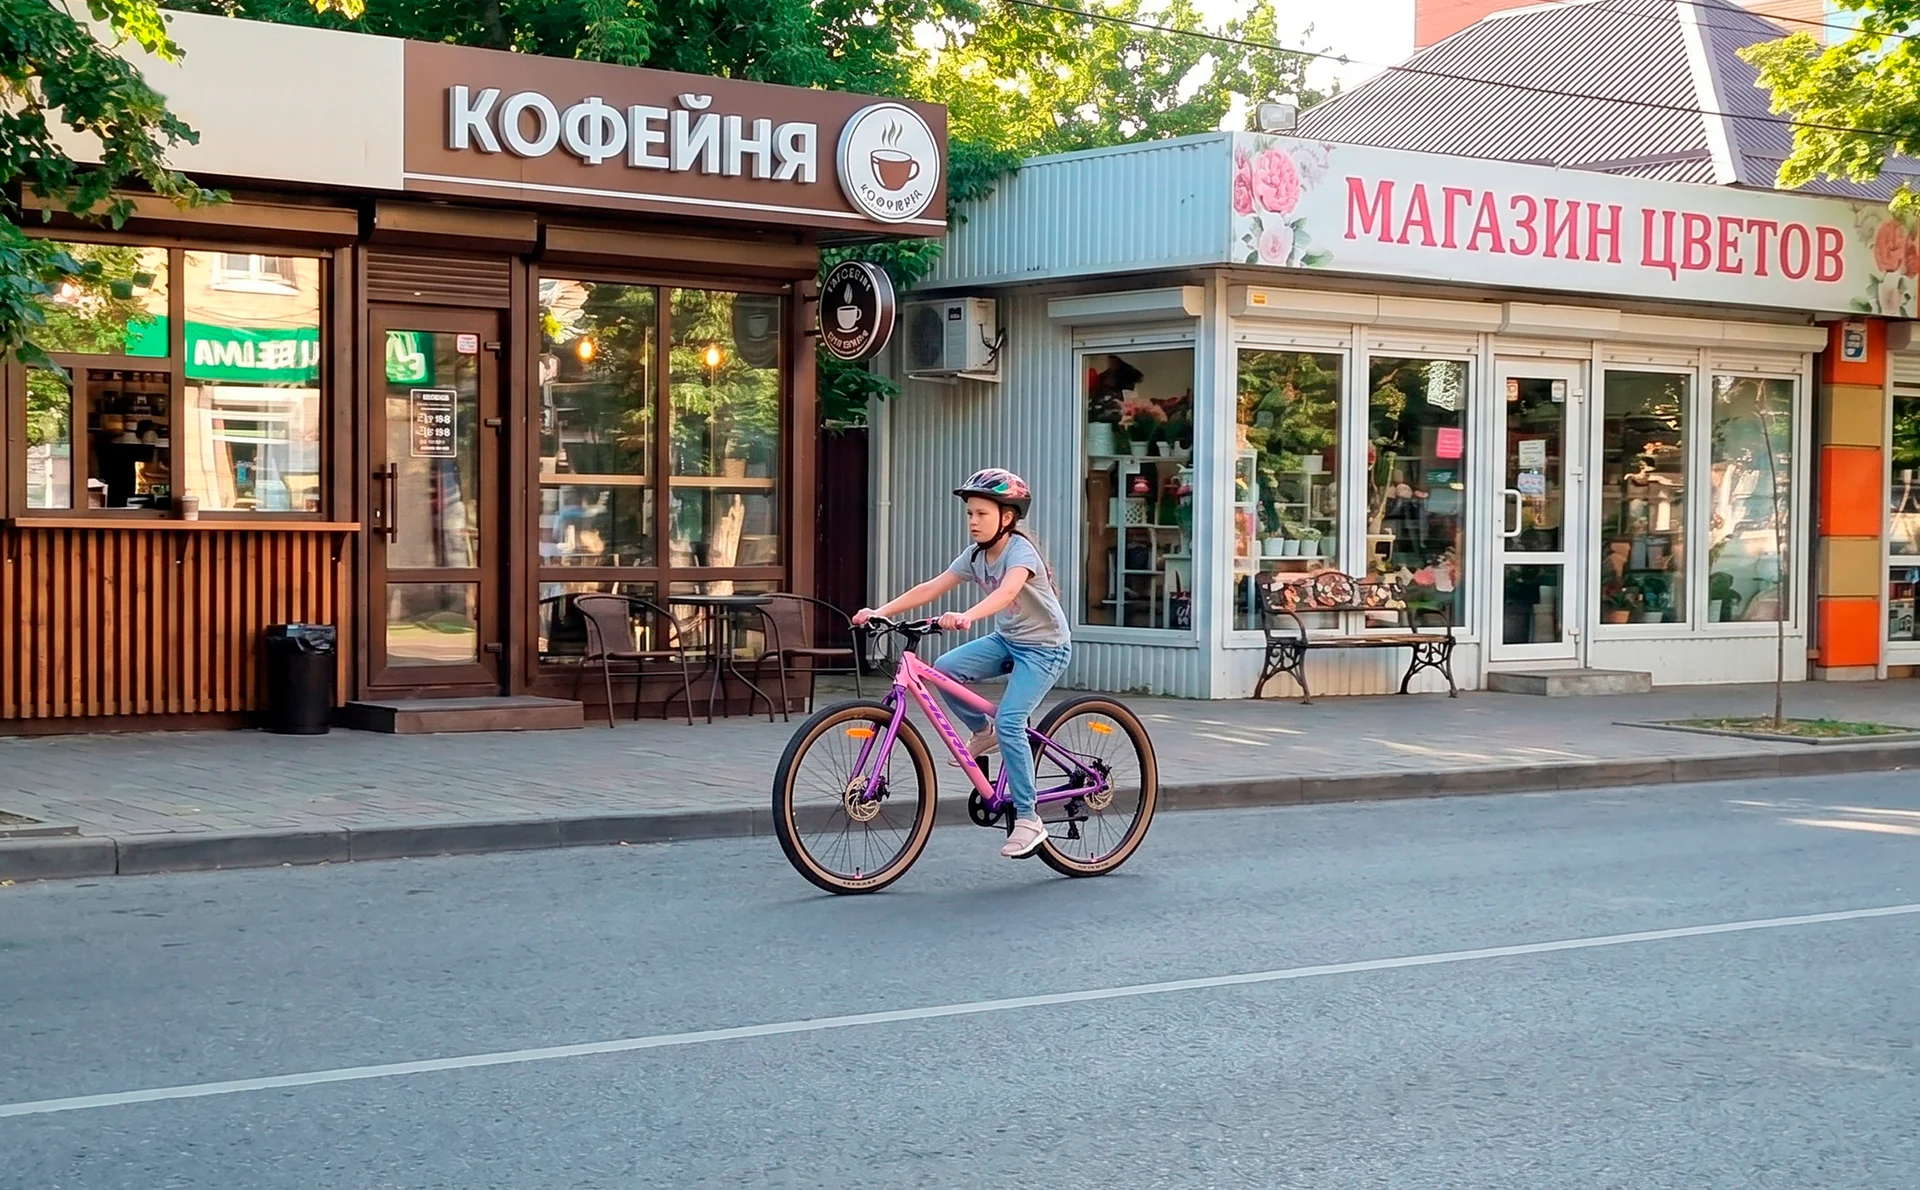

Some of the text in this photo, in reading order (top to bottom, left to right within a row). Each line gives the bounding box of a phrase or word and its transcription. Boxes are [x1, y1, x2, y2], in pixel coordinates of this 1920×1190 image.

[449, 85, 817, 183] КОФЕЙНЯ
[1344, 176, 1845, 283] МАГАЗИН ЦВЕТОВ
